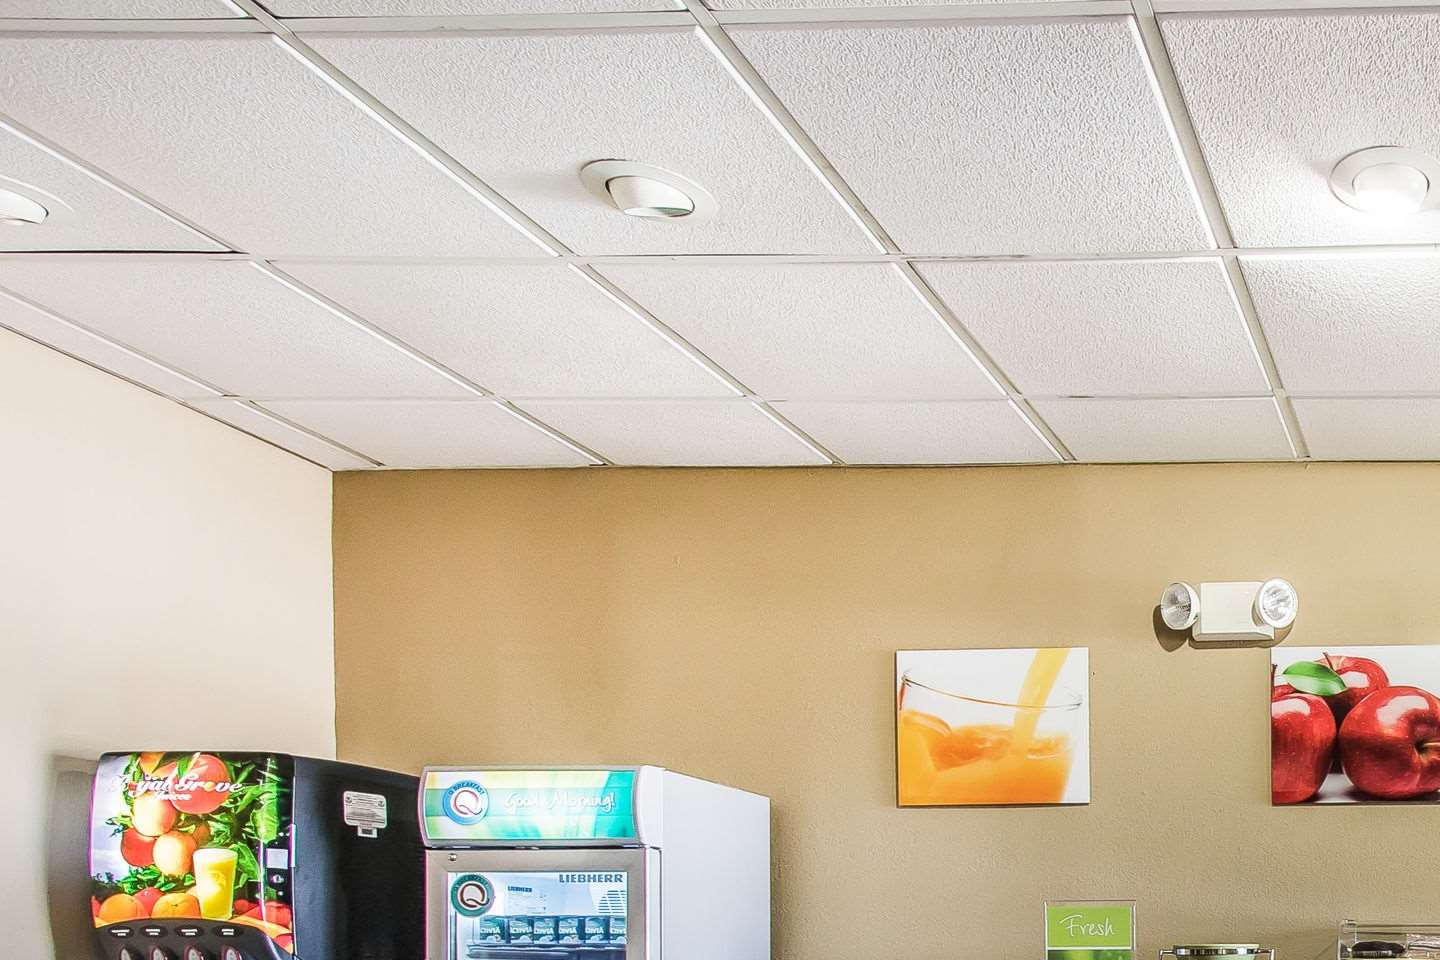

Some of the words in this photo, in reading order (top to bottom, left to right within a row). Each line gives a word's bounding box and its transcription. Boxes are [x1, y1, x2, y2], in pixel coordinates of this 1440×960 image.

[504, 791, 540, 814] Good
[549, 791, 616, 812] Morning!
[559, 874, 624, 884] LIEBHERR
[1060, 914, 1115, 937] Fresh
